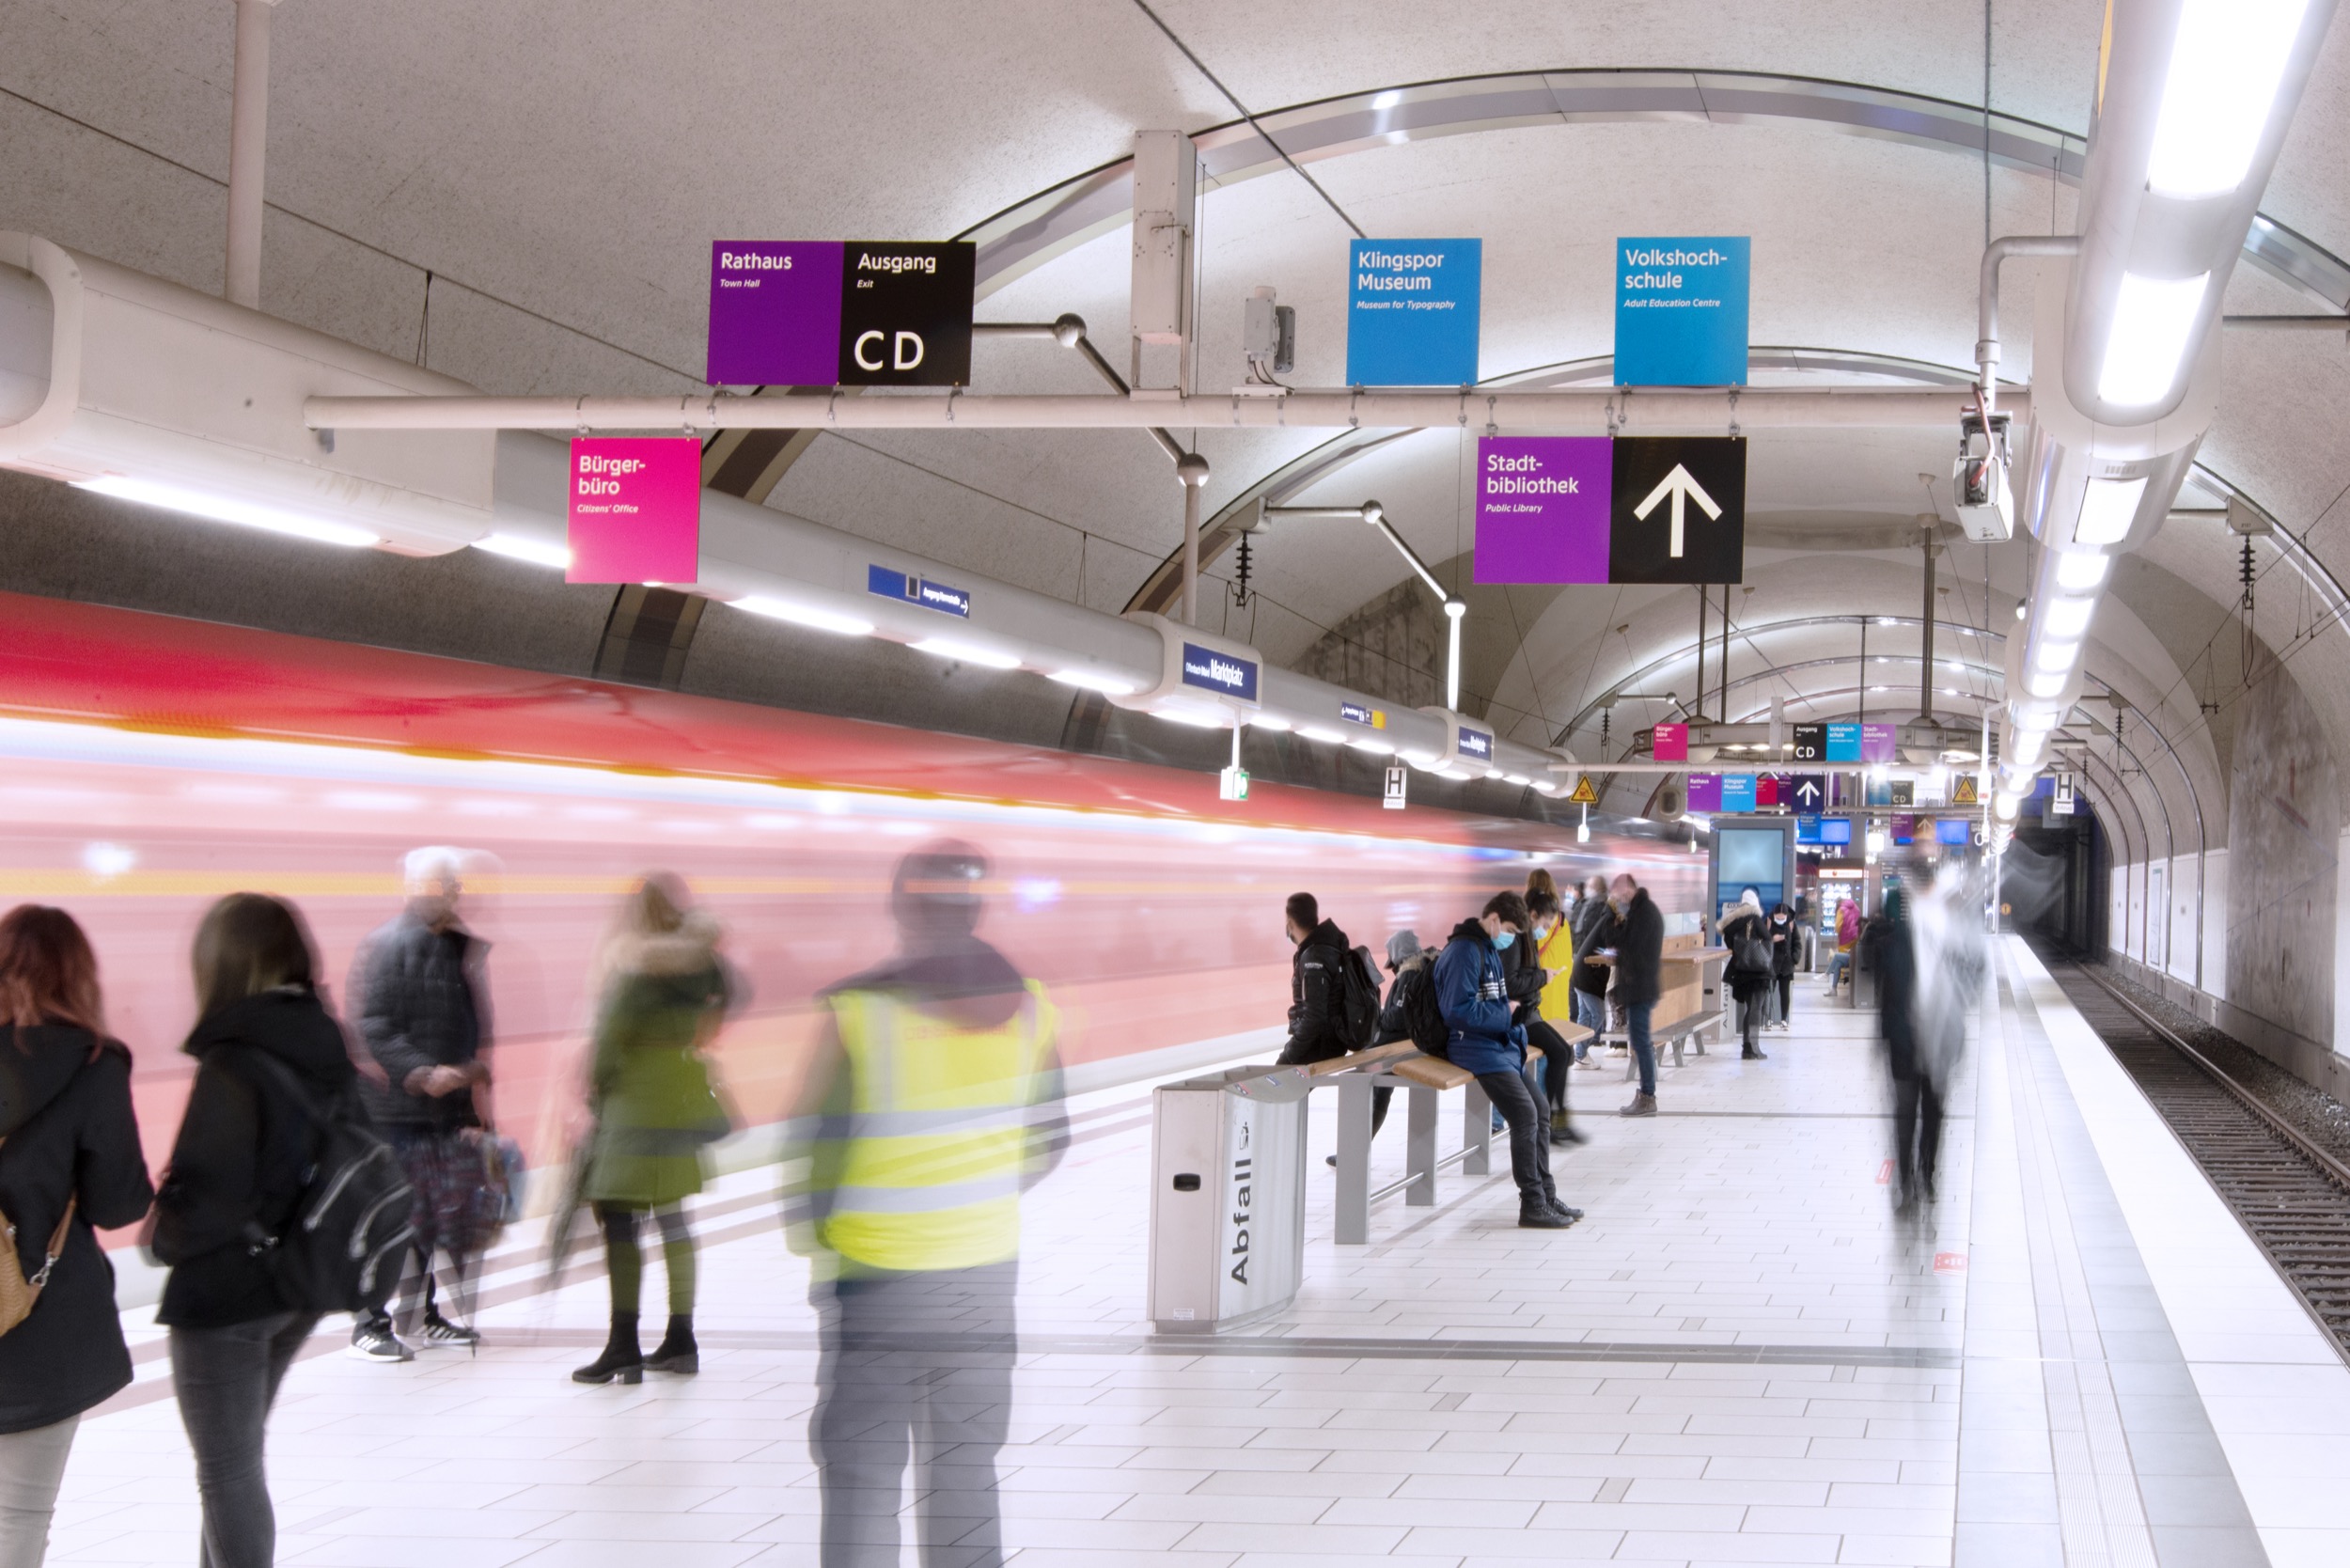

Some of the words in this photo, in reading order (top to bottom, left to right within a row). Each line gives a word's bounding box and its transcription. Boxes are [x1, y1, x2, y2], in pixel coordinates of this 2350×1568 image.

[721, 252, 792, 270] Rathaus
[857, 253, 936, 274] Ausgang
[1358, 251, 1445, 272] Klingspor
[1625, 248, 1728, 266] Volkshoch-
[720, 279, 742, 288] Town
[744, 279, 760, 288] Hall
[856, 279, 874, 289] Exit
[1357, 274, 1432, 290] Museum
[1624, 272, 1683, 289] schule
[1356, 301, 1390, 309] Museum
[1392, 301, 1404, 309] for
[1407, 301, 1456, 310] Typography
[1623, 299, 1647, 307] Adult
[1649, 299, 1690, 307] Education
[1693, 299, 1721, 307] Centre
[579, 456, 646, 477] Bürger-
[1487, 454, 1543, 472] Stadt-
[578, 478, 620, 495] büro
[1486, 477, 1579, 494] bibliothek
[613, 504, 639, 513] Office
[1485, 503, 1512, 513] Public
[1512, 503, 1543, 514] Library
[1211, 658, 1243, 687] Marktplatz
[1387, 769, 1402, 794] H
[2057, 774, 2072, 798] H
[1231, 1158, 1251, 1285] Abfall
